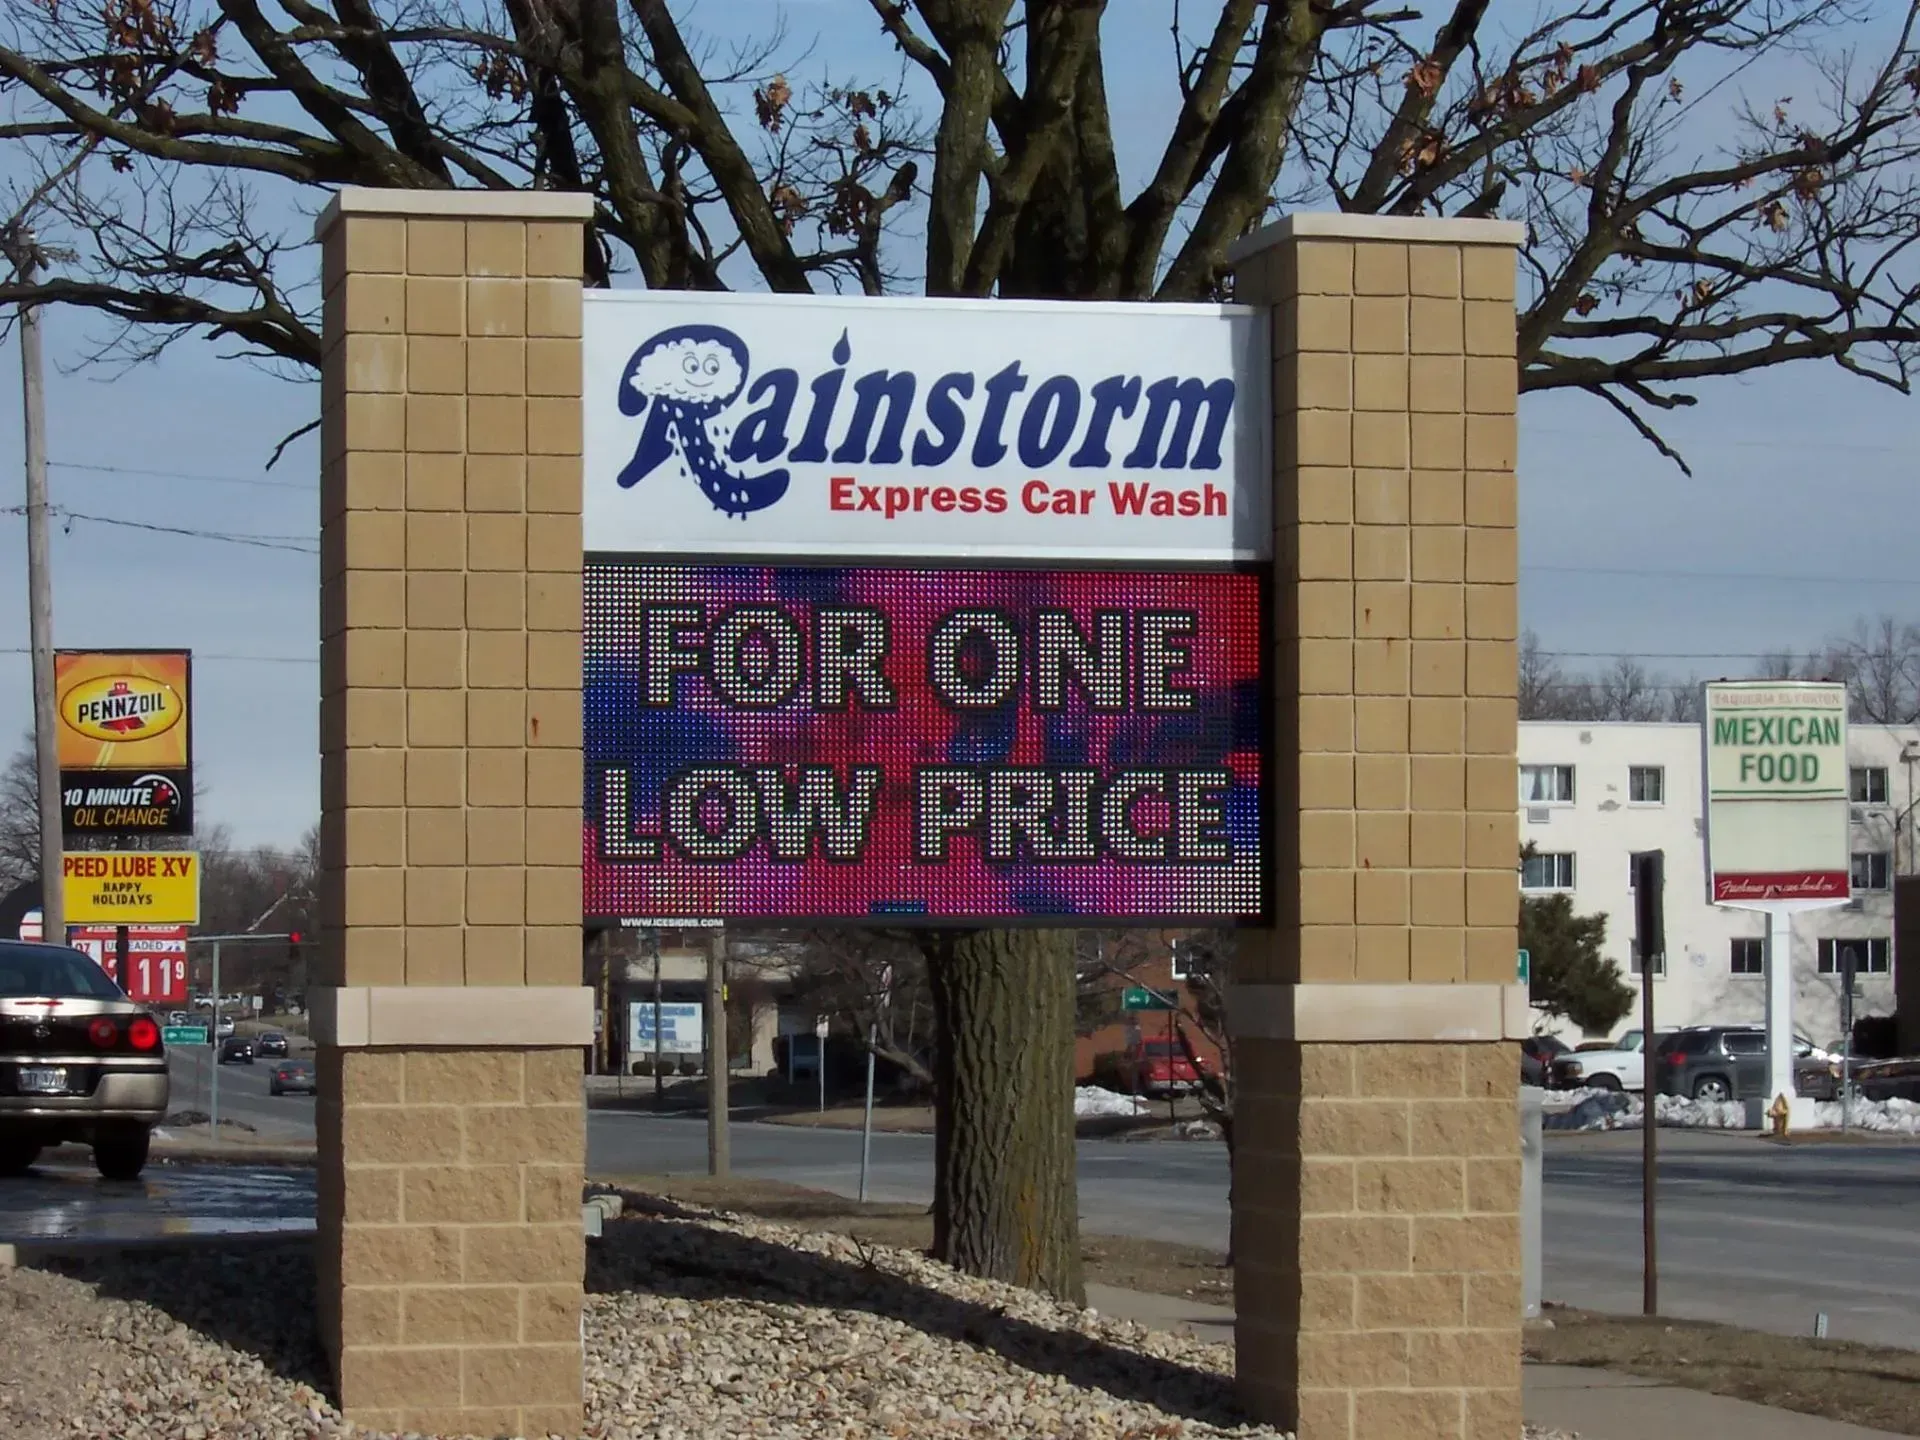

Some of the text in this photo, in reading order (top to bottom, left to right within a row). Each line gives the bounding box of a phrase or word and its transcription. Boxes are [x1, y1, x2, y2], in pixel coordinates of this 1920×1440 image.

[616, 323, 1236, 521] Rainstorm
[829, 477, 1228, 520] Express Car Wash
[645, 607, 1195, 708] FOR ONE
[78, 692, 166, 723] PENNZOIL
[1713, 716, 1841, 746] MEXICAN
[1740, 753, 1819, 783] FOOD
[64, 788, 153, 806] 10 MINUTE
[74, 808, 170, 826] OIL CHANGE
[603, 767, 1228, 859] LOW PRICE
[63, 856, 192, 878] PEED LUBE XV
[92, 894, 153, 906] HOLIDAYS
[103, 882, 142, 893] HAPPY
